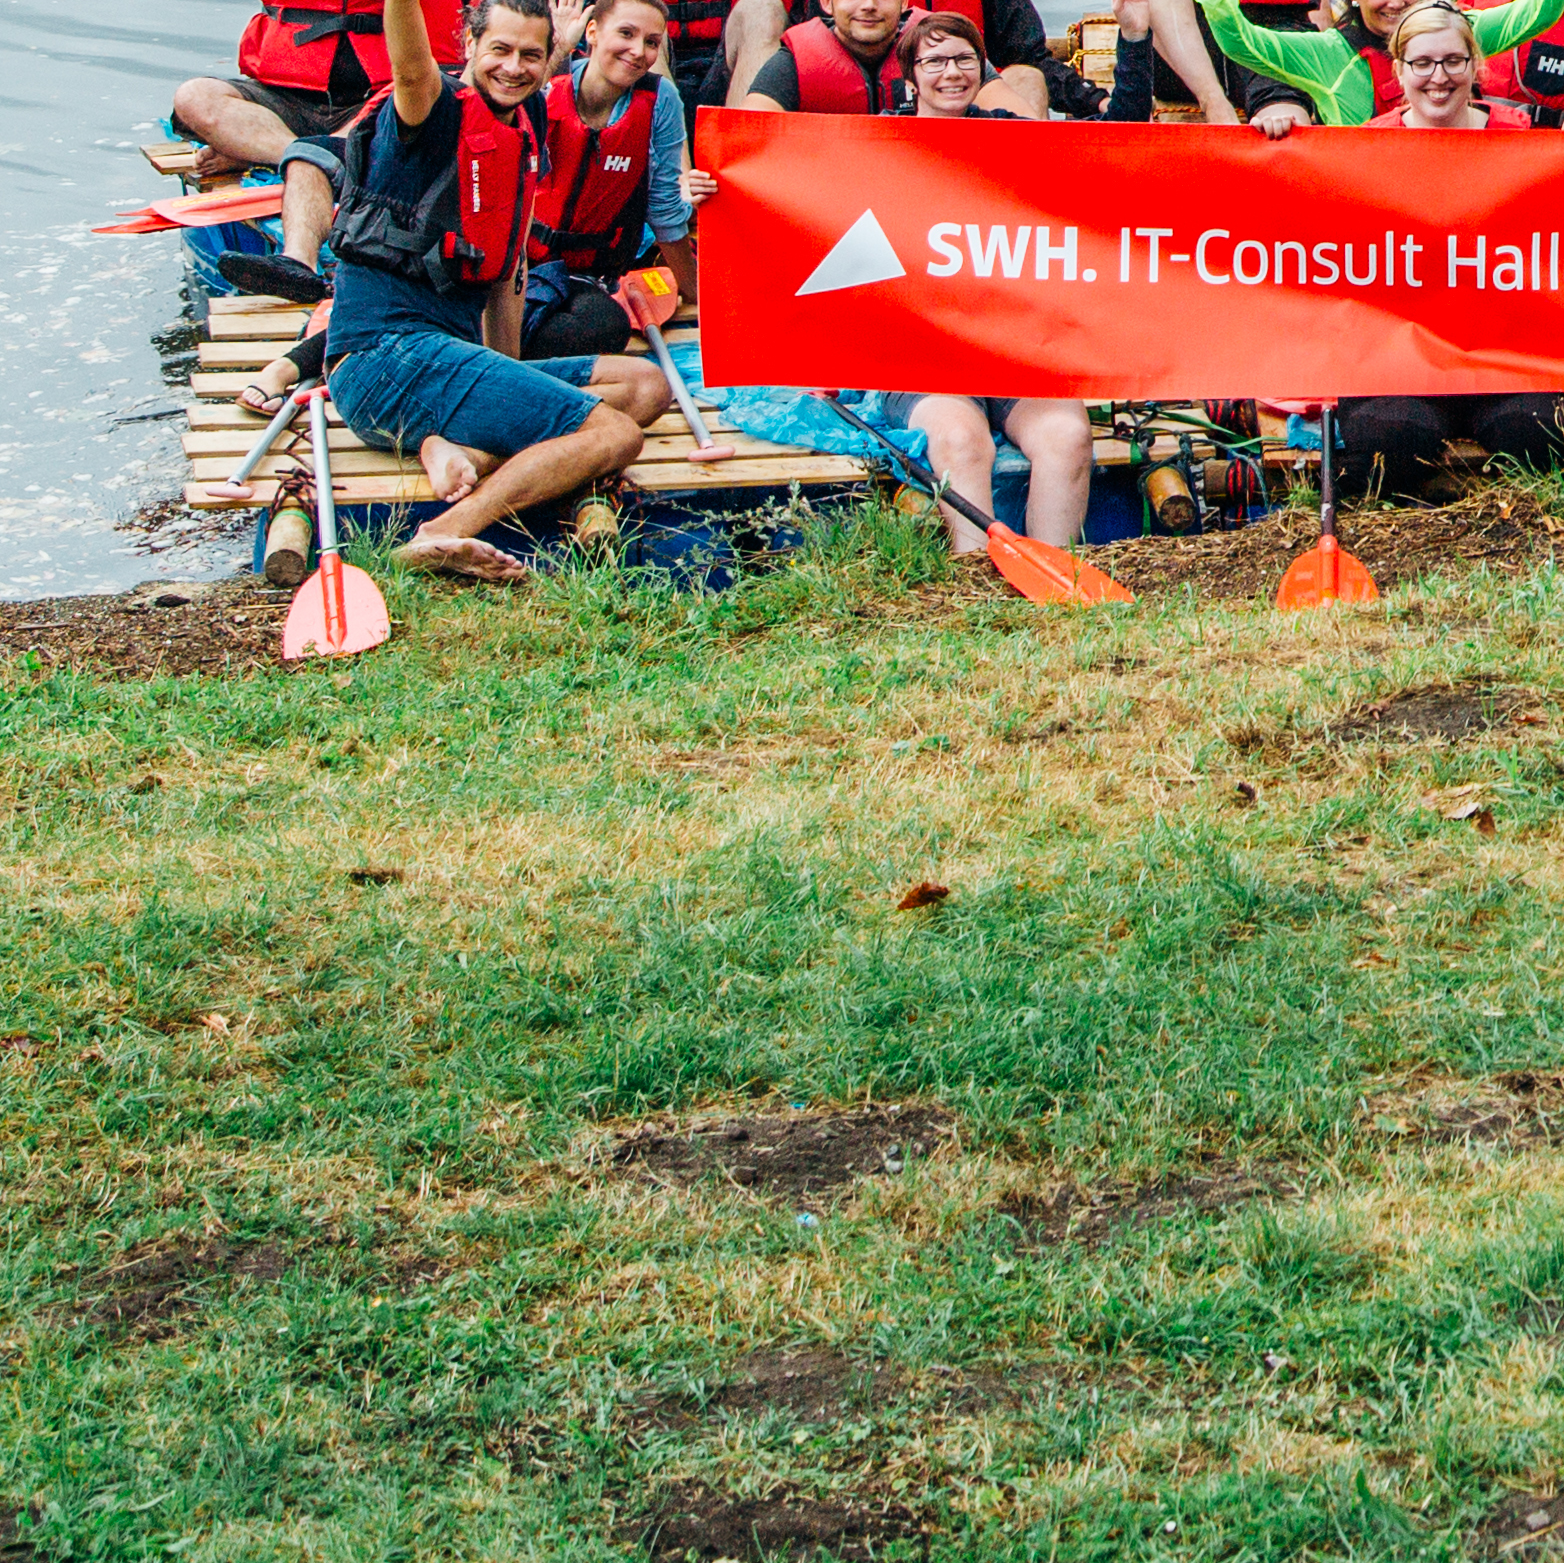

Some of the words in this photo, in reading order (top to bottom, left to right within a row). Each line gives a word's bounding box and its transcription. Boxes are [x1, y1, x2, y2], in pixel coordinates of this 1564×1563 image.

[604, 155, 631, 172] HH
[926, 222, 1098, 283] SWH.
[1118, 227, 1423, 287] IT-Consult
